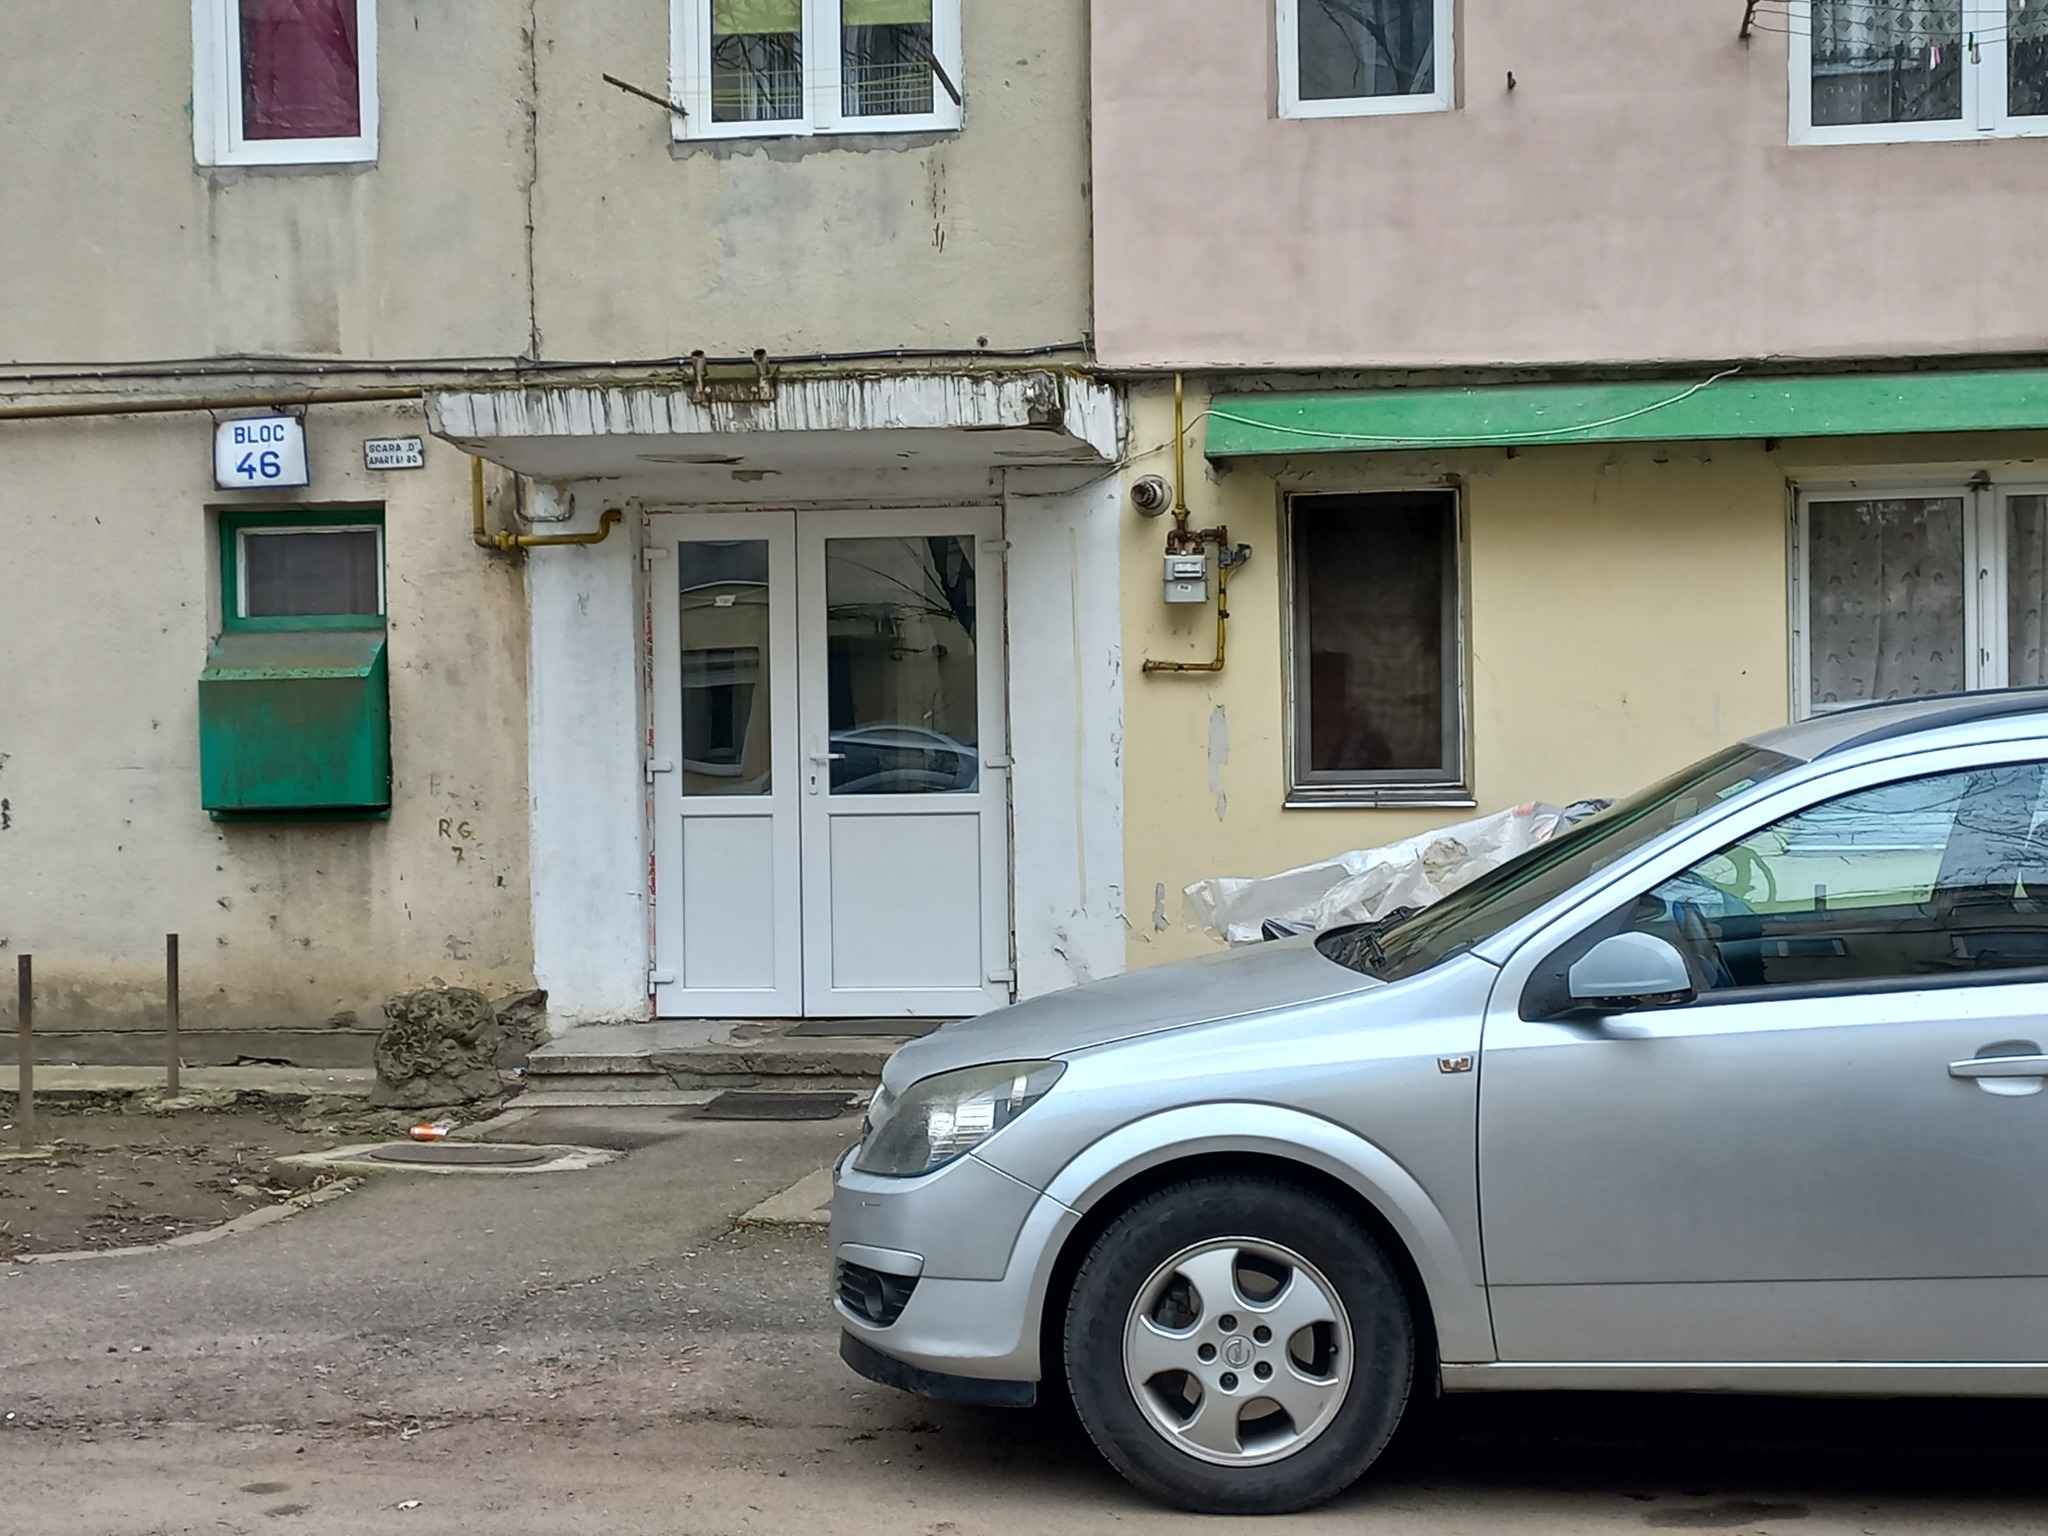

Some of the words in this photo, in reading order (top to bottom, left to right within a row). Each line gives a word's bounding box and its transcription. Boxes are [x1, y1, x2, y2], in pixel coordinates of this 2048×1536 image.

[234, 424, 285, 444] BLOC
[369, 443, 402, 453] SCARA
[236, 450, 281, 480] 46
